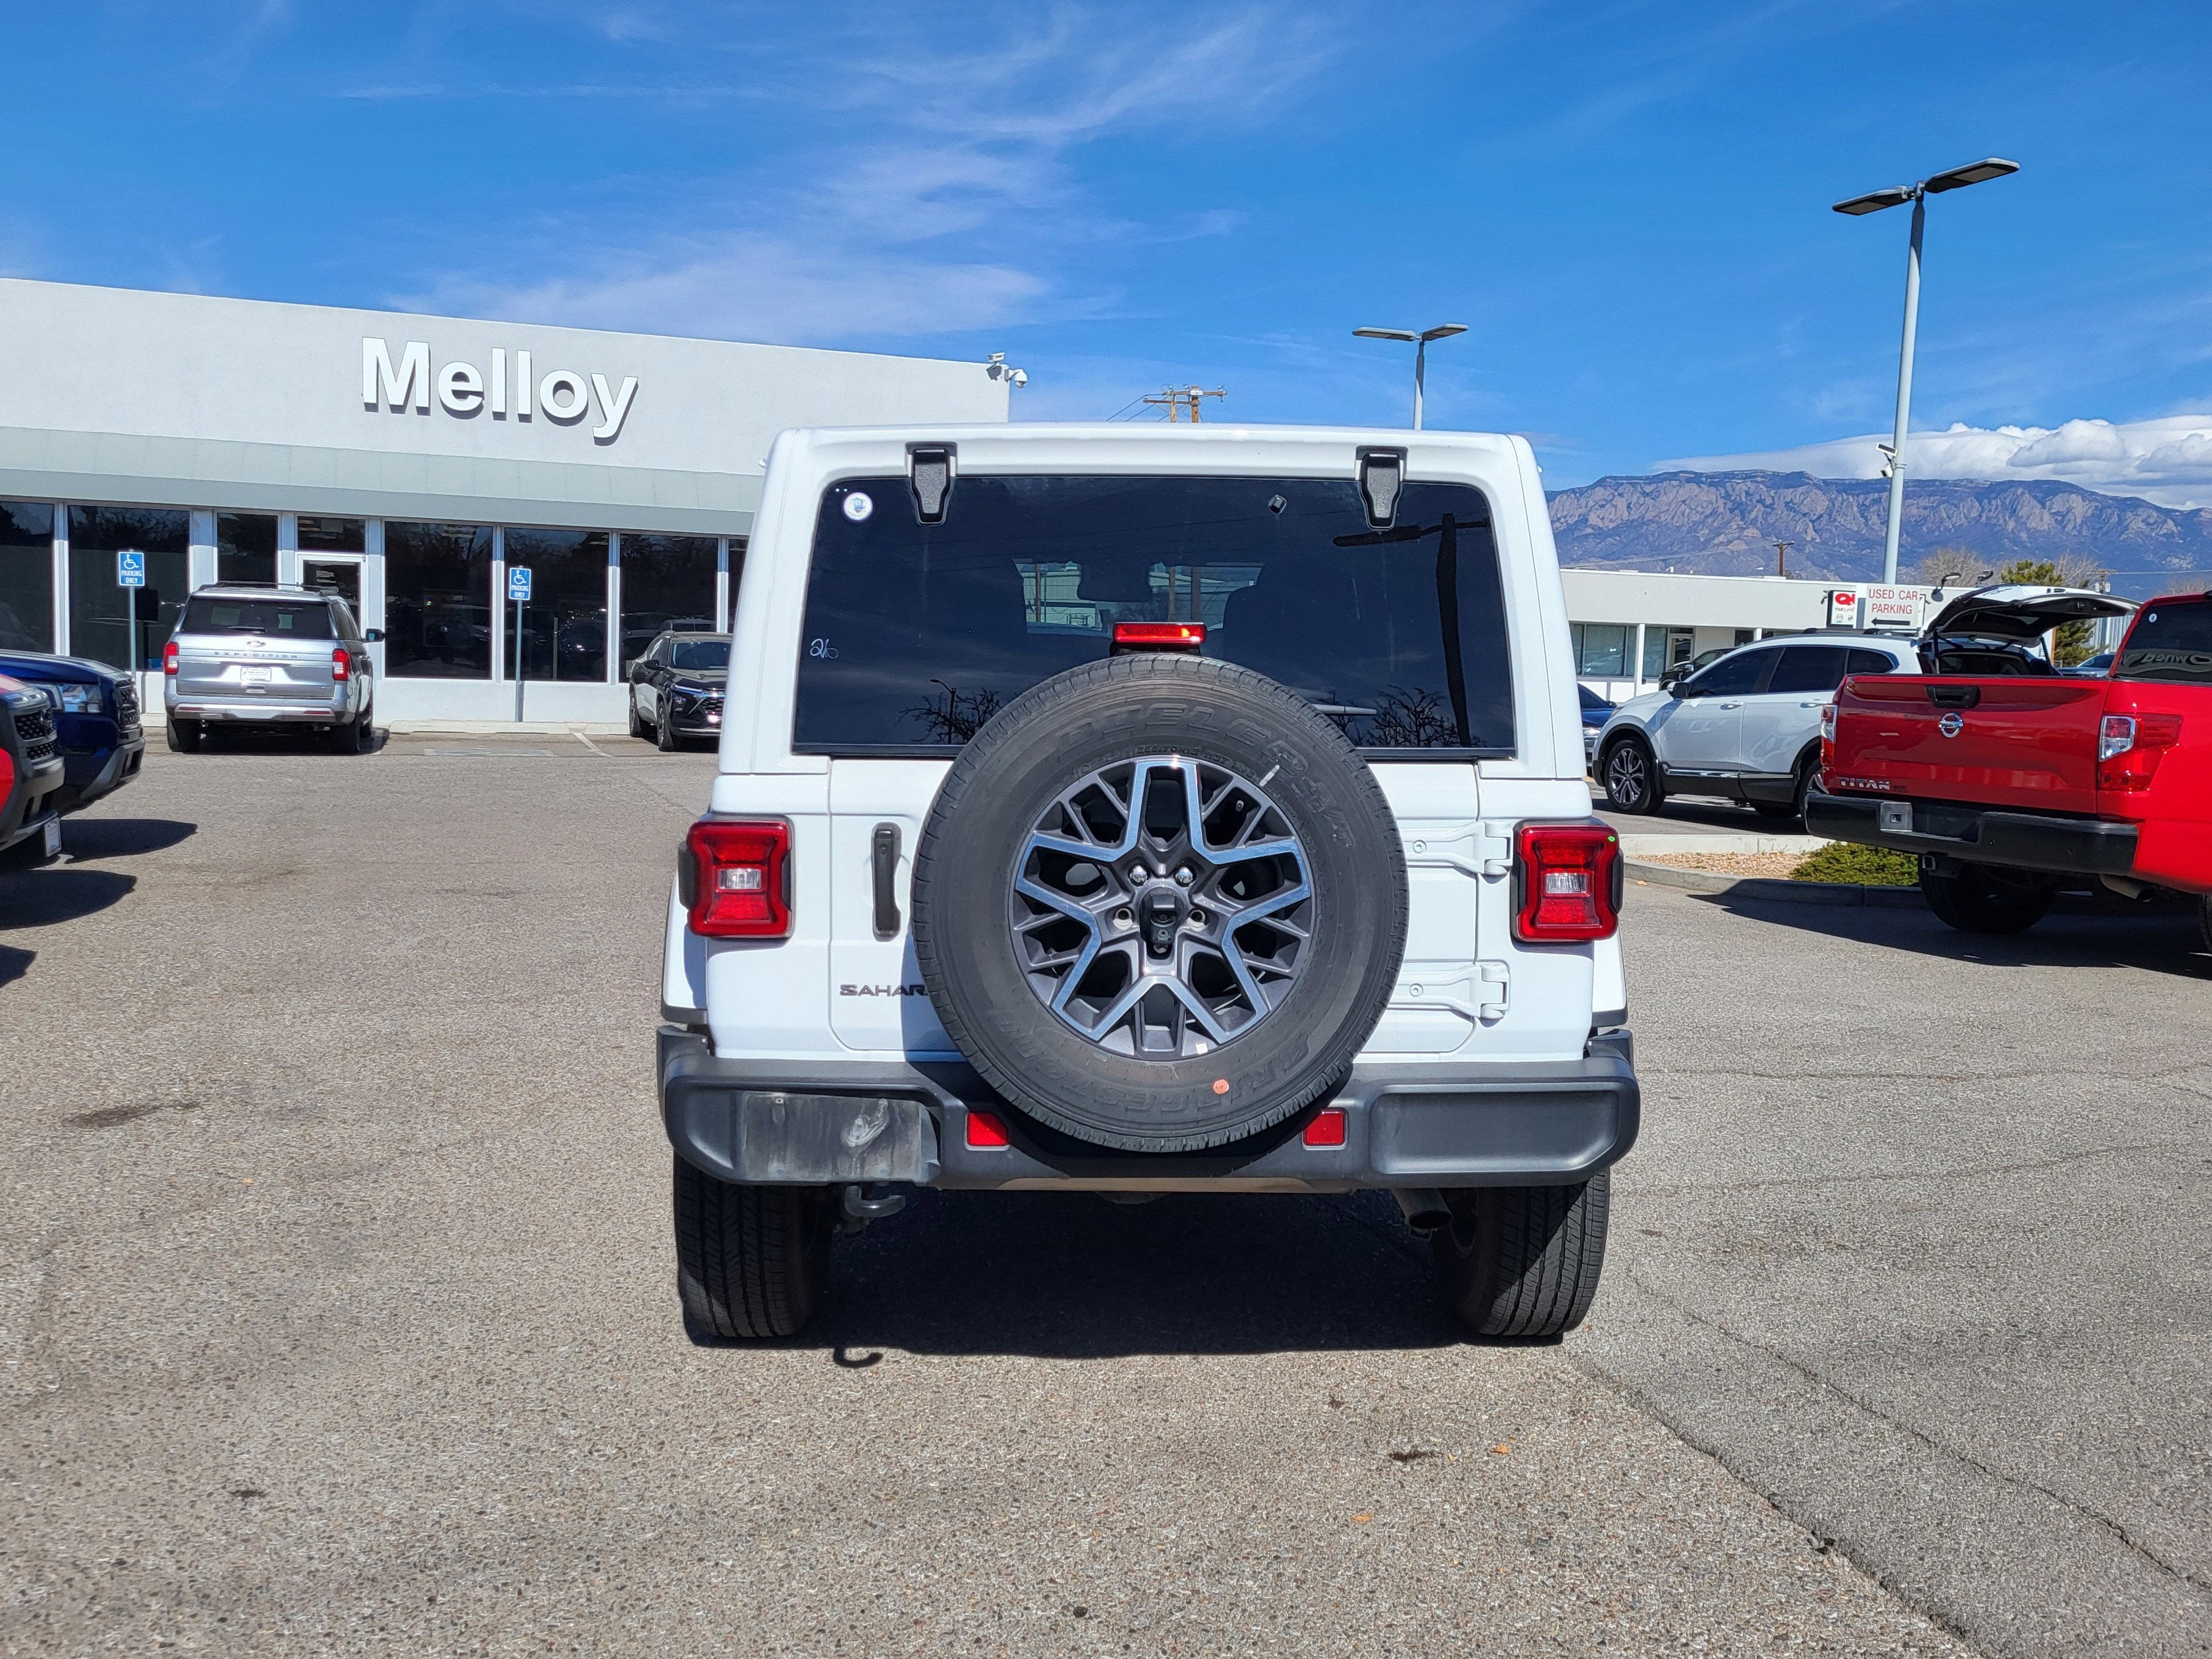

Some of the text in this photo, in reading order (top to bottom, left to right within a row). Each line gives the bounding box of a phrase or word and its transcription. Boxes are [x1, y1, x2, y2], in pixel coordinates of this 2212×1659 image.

[362, 337, 639, 442] Melloy
[1869, 588, 1918, 601] USED CAR
[1871, 603, 1912, 614] PARKING
[1837, 776, 1891, 790] TITAN
[839, 984, 928, 997] SAHAR
